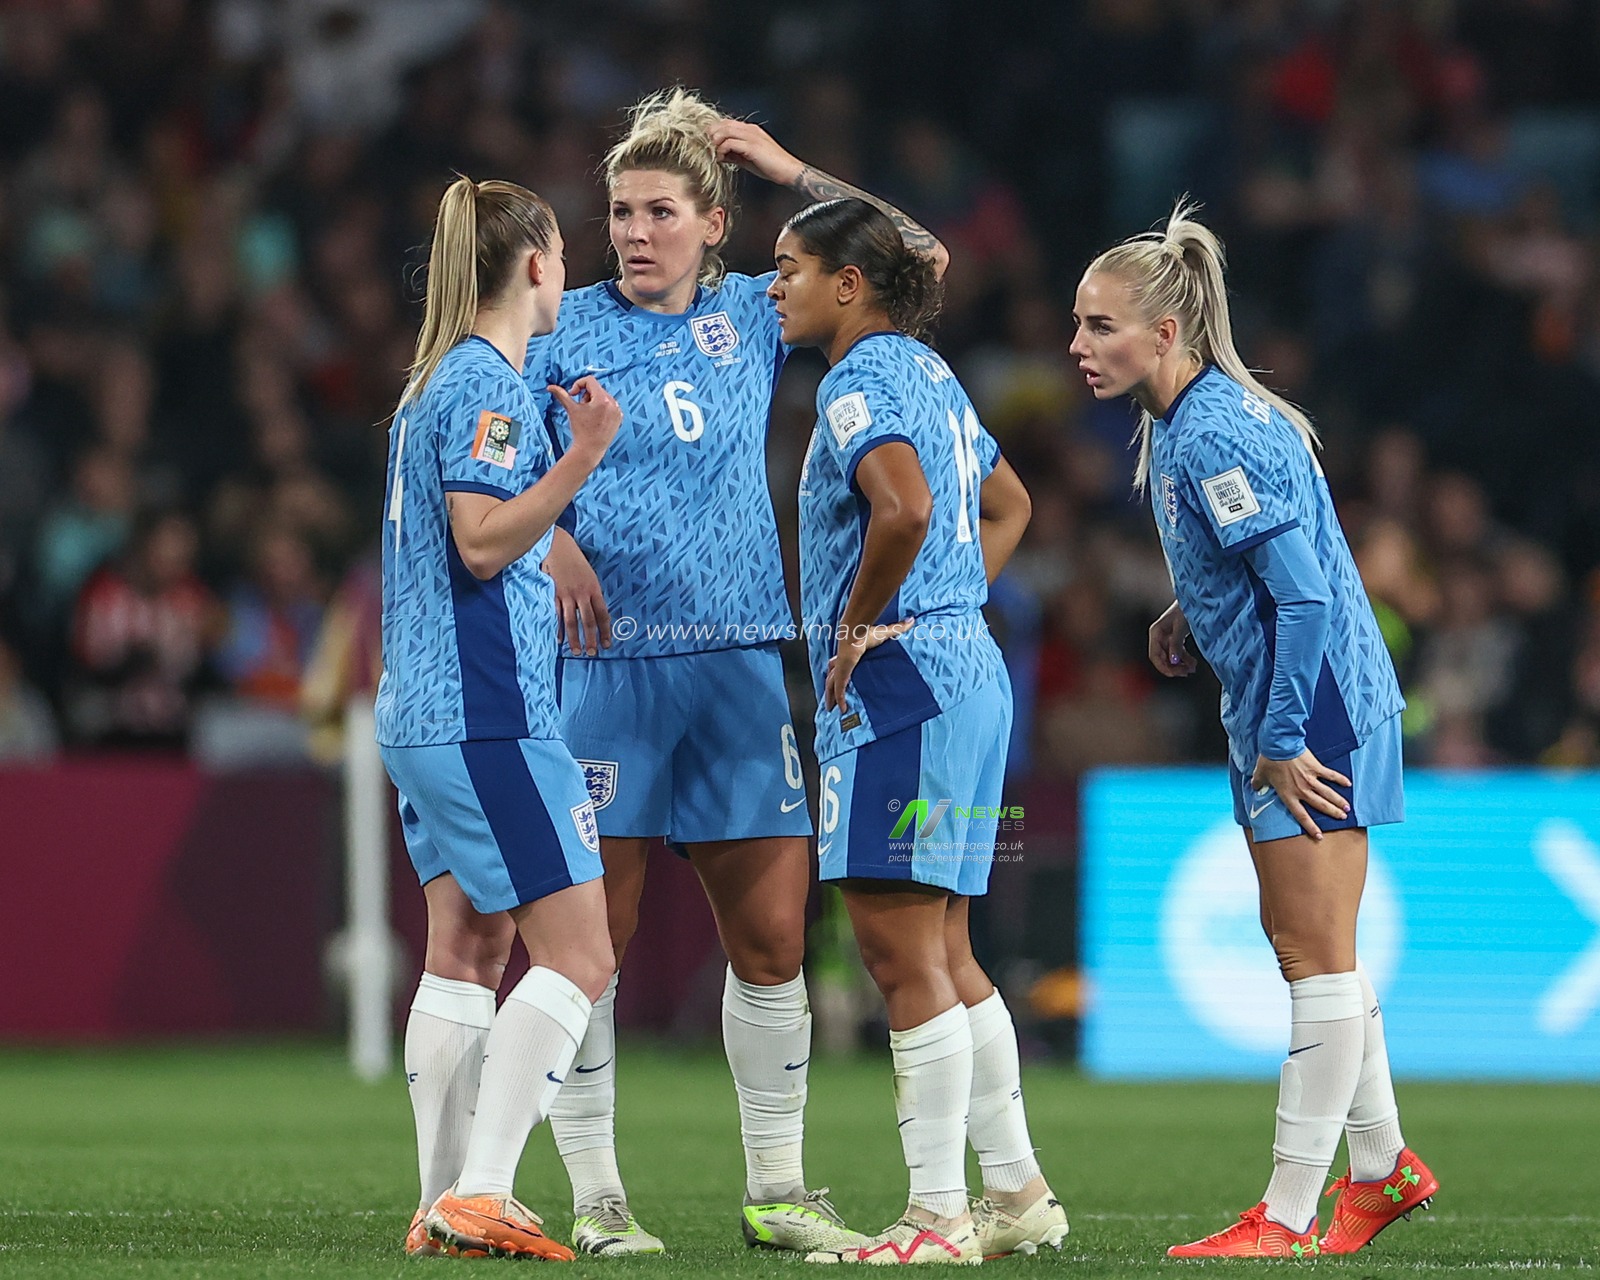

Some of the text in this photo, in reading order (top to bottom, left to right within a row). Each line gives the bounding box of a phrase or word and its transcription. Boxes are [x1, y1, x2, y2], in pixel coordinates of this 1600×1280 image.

[663, 380, 705, 443] 6
[1213, 479, 1237, 491] FOOTBALL
[1216, 485, 1241, 500] UNITES
[780, 723, 803, 790] 6
